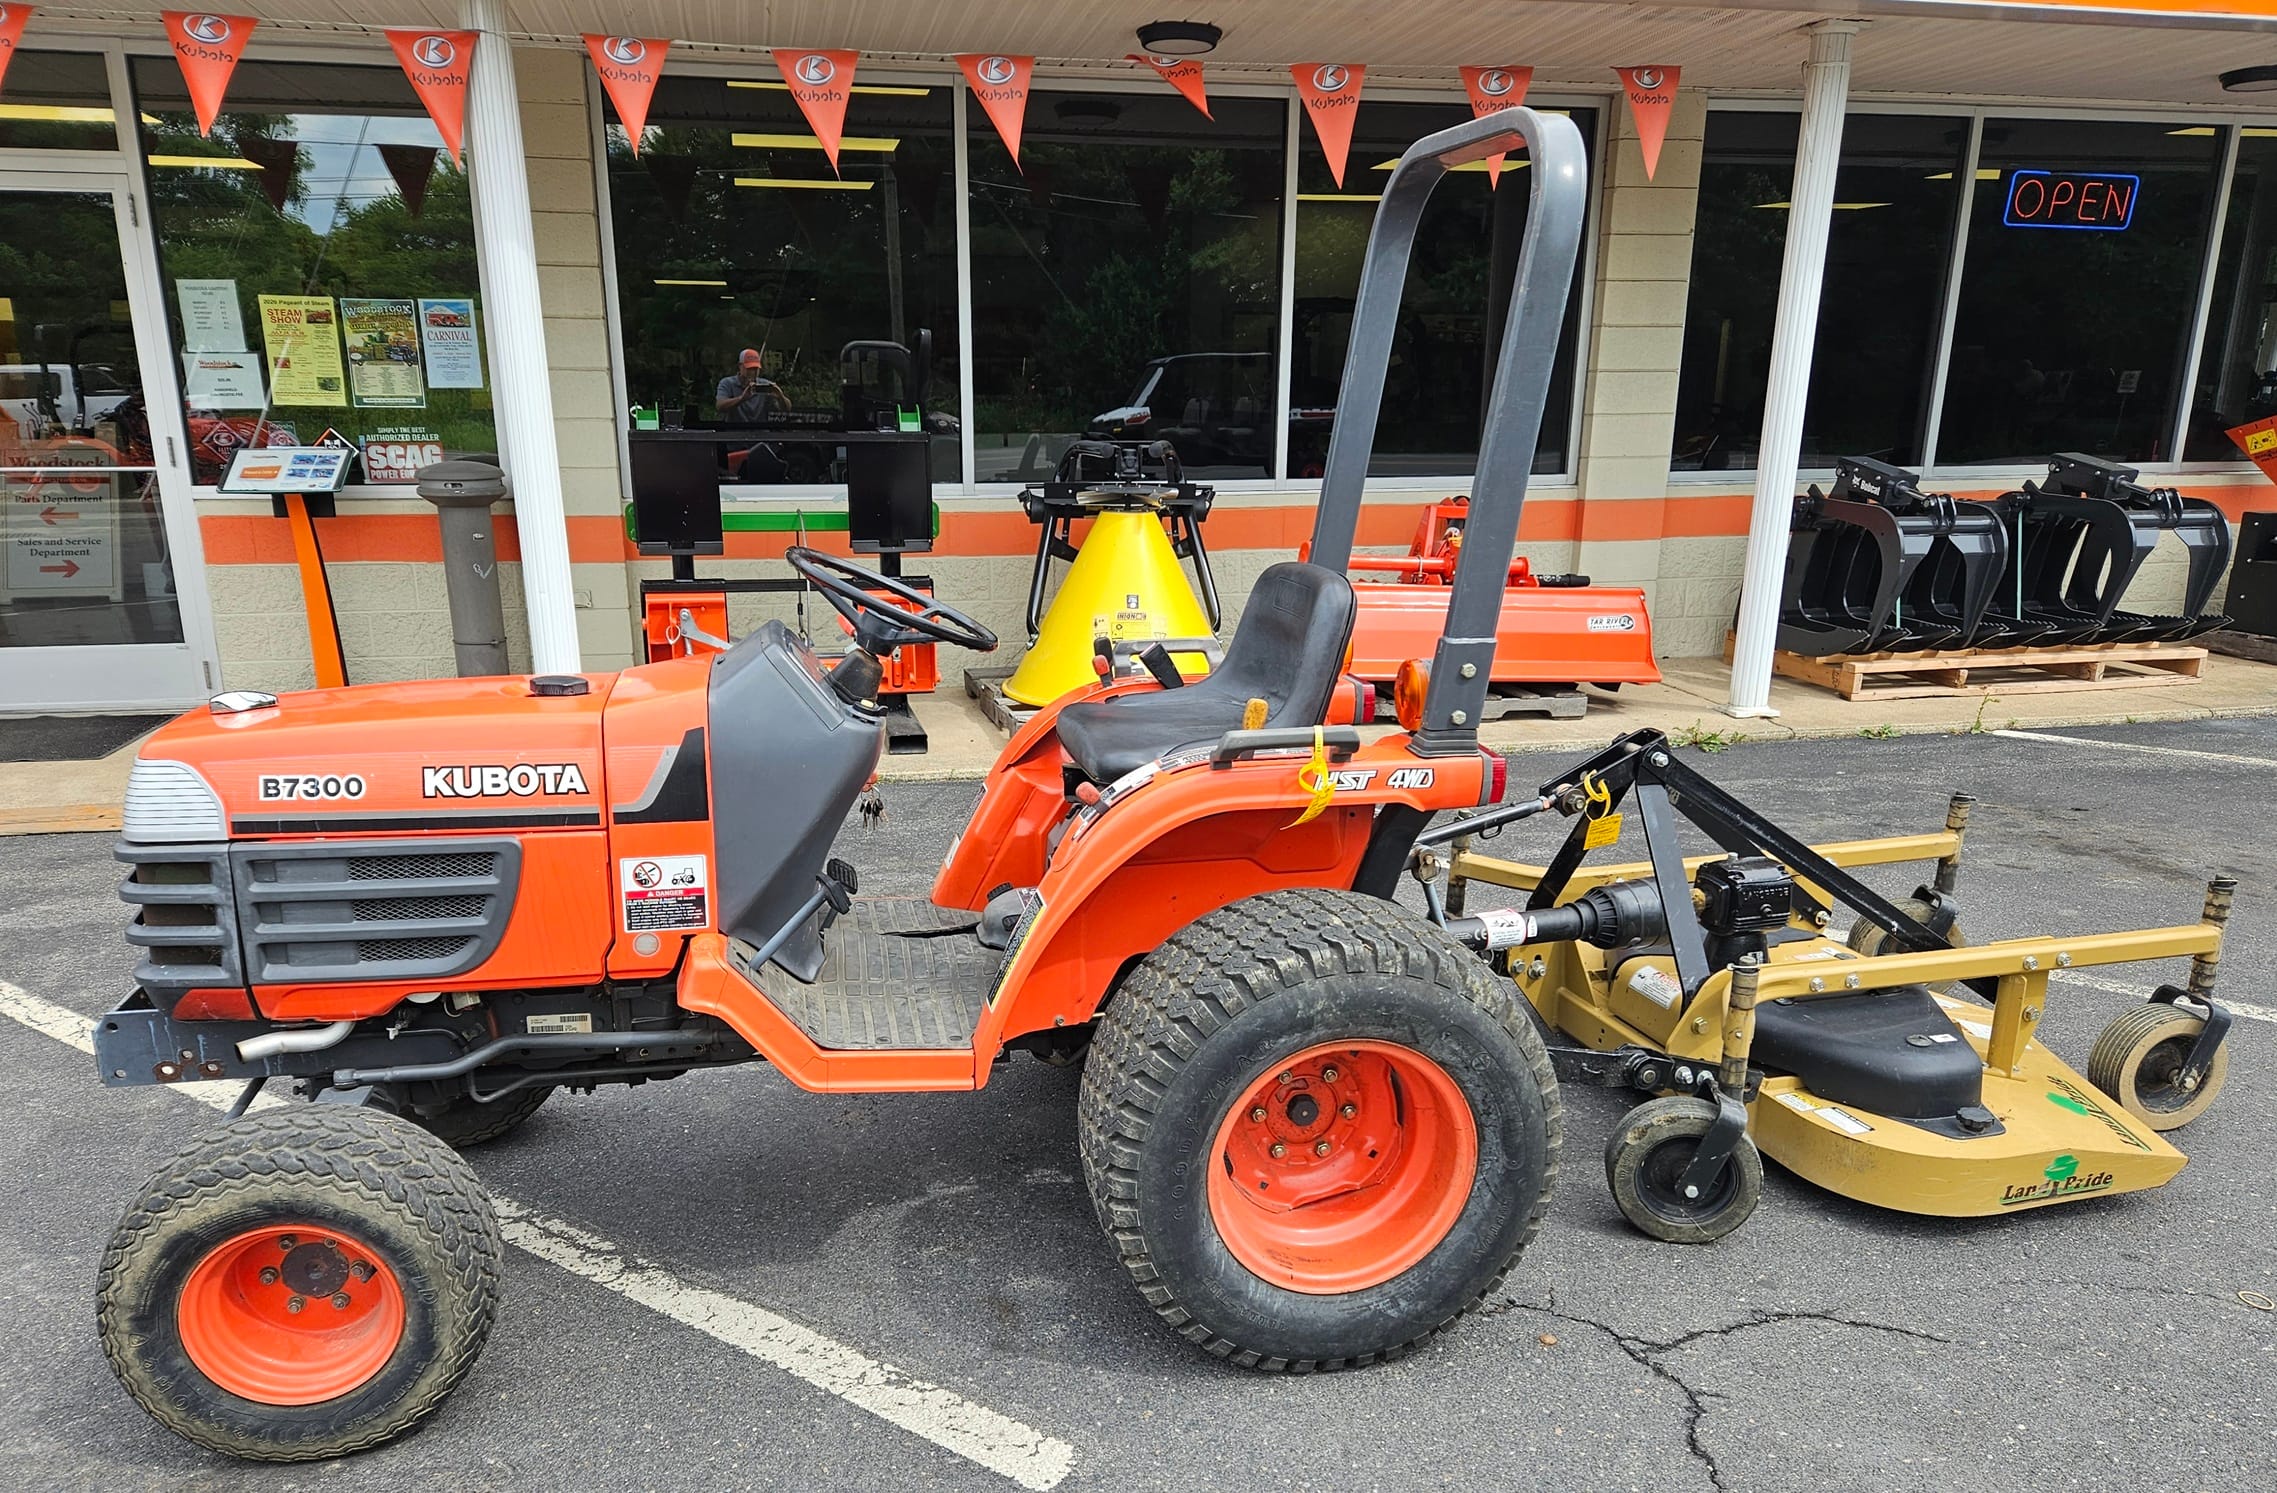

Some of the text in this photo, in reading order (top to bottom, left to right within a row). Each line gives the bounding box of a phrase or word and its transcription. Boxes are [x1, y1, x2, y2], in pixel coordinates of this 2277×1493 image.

[176, 41, 233, 63] Kubota
[412, 71, 464, 88] Kubota
[600, 66, 651, 84] Kubota
[794, 88, 843, 103] Kubota
[977, 88, 1023, 103] Kubota
[1310, 94, 1355, 110] Kubota
[1631, 91, 1669, 105] Kubota
[2014, 179, 2131, 222] OPEN
[267, 308, 302, 317] STEAM
[270, 316, 300, 324] SHOW
[427, 330, 472, 341] CARNIVAL
[367, 444, 442, 469] SCAG
[370, 470, 398, 479] POWER
[1860, 479, 1881, 496] Bobcat
[15, 495, 103, 505] Parts Department
[17, 537, 102, 546] Sales and Service
[30, 548, 90, 558] Department
[422, 763, 589, 798] KUBOTA
[1386, 768, 1434, 789] 4WD
[262, 776, 363, 799] B7300
[655, 889, 683, 897] DANGER
[2063, 1172, 2113, 1190] Pride
